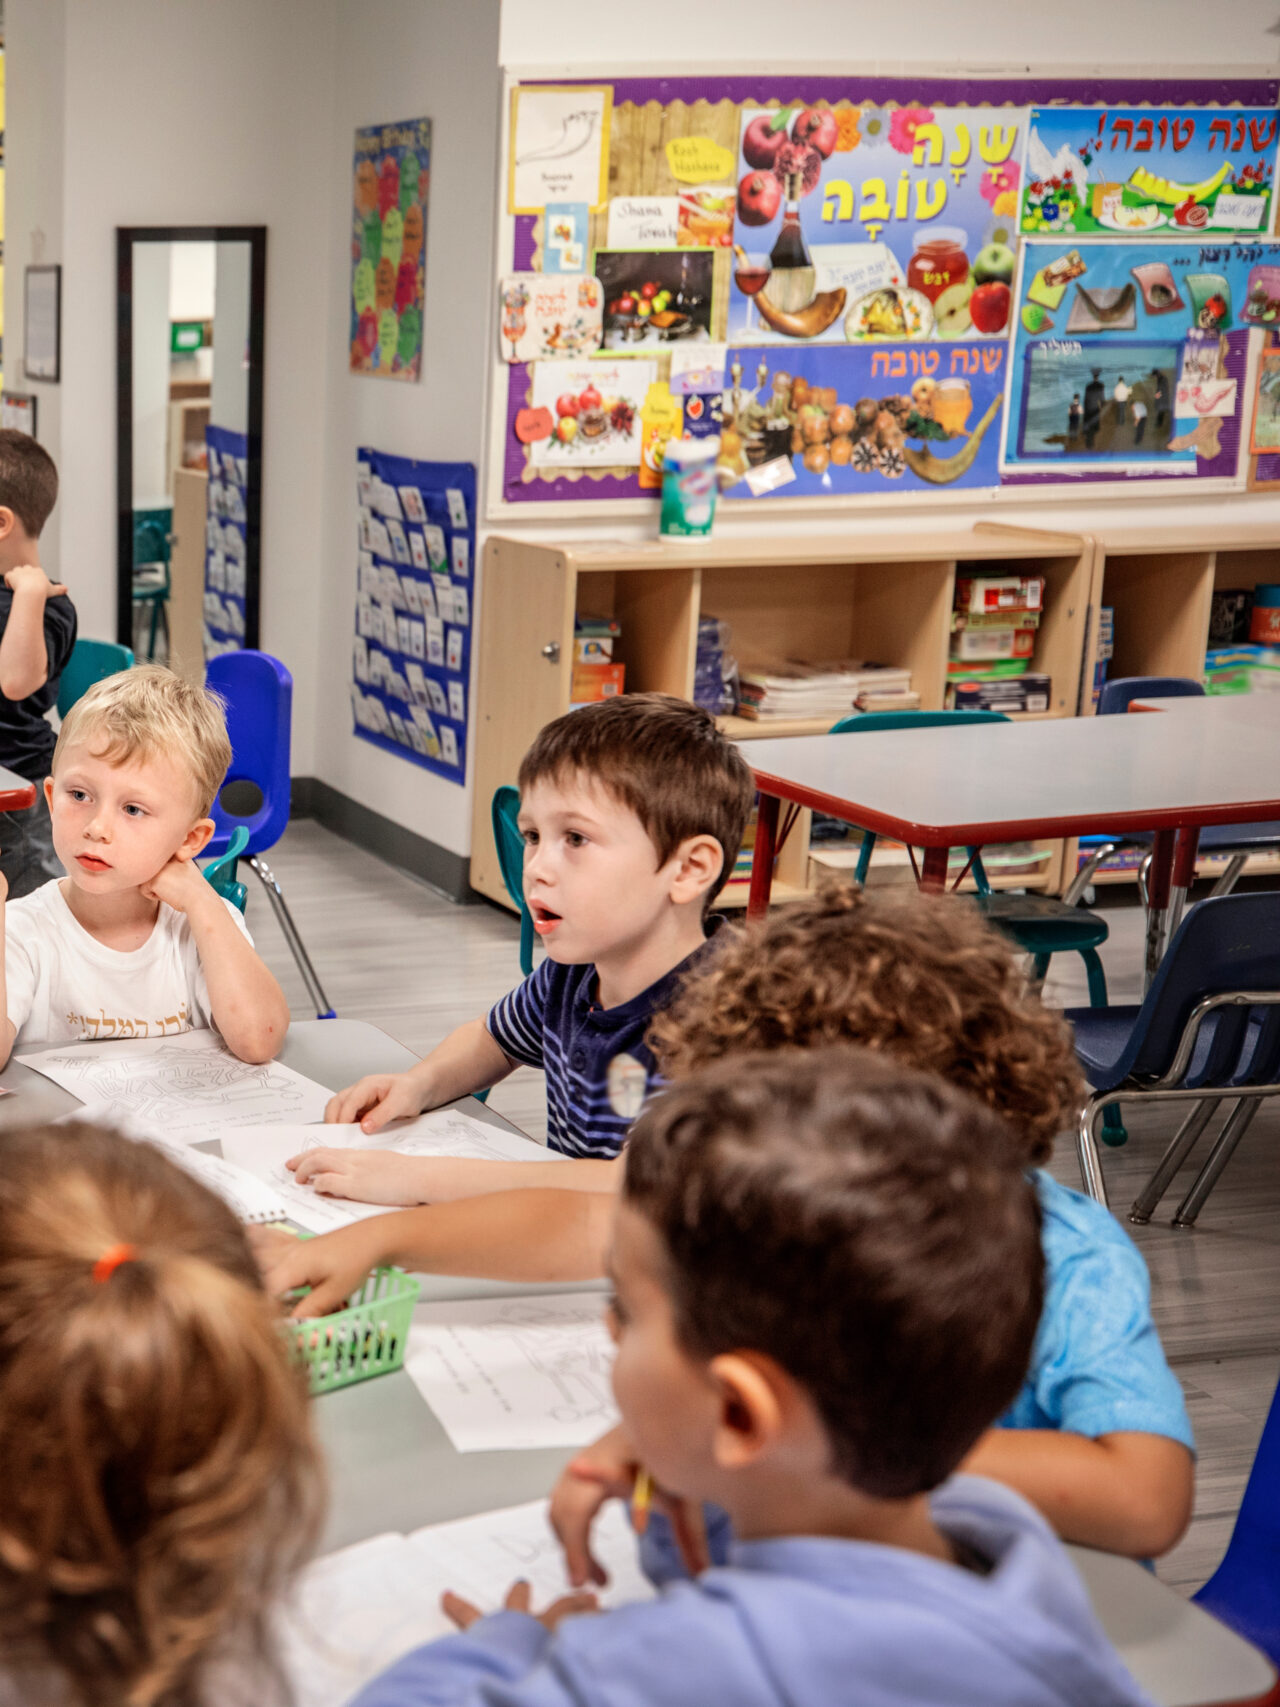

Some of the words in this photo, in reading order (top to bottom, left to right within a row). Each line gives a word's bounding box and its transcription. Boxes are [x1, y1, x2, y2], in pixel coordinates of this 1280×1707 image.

[1208, 116, 1277, 152] שנה
[871, 349, 940, 377] טובה
[951, 347, 1002, 374] שנה
